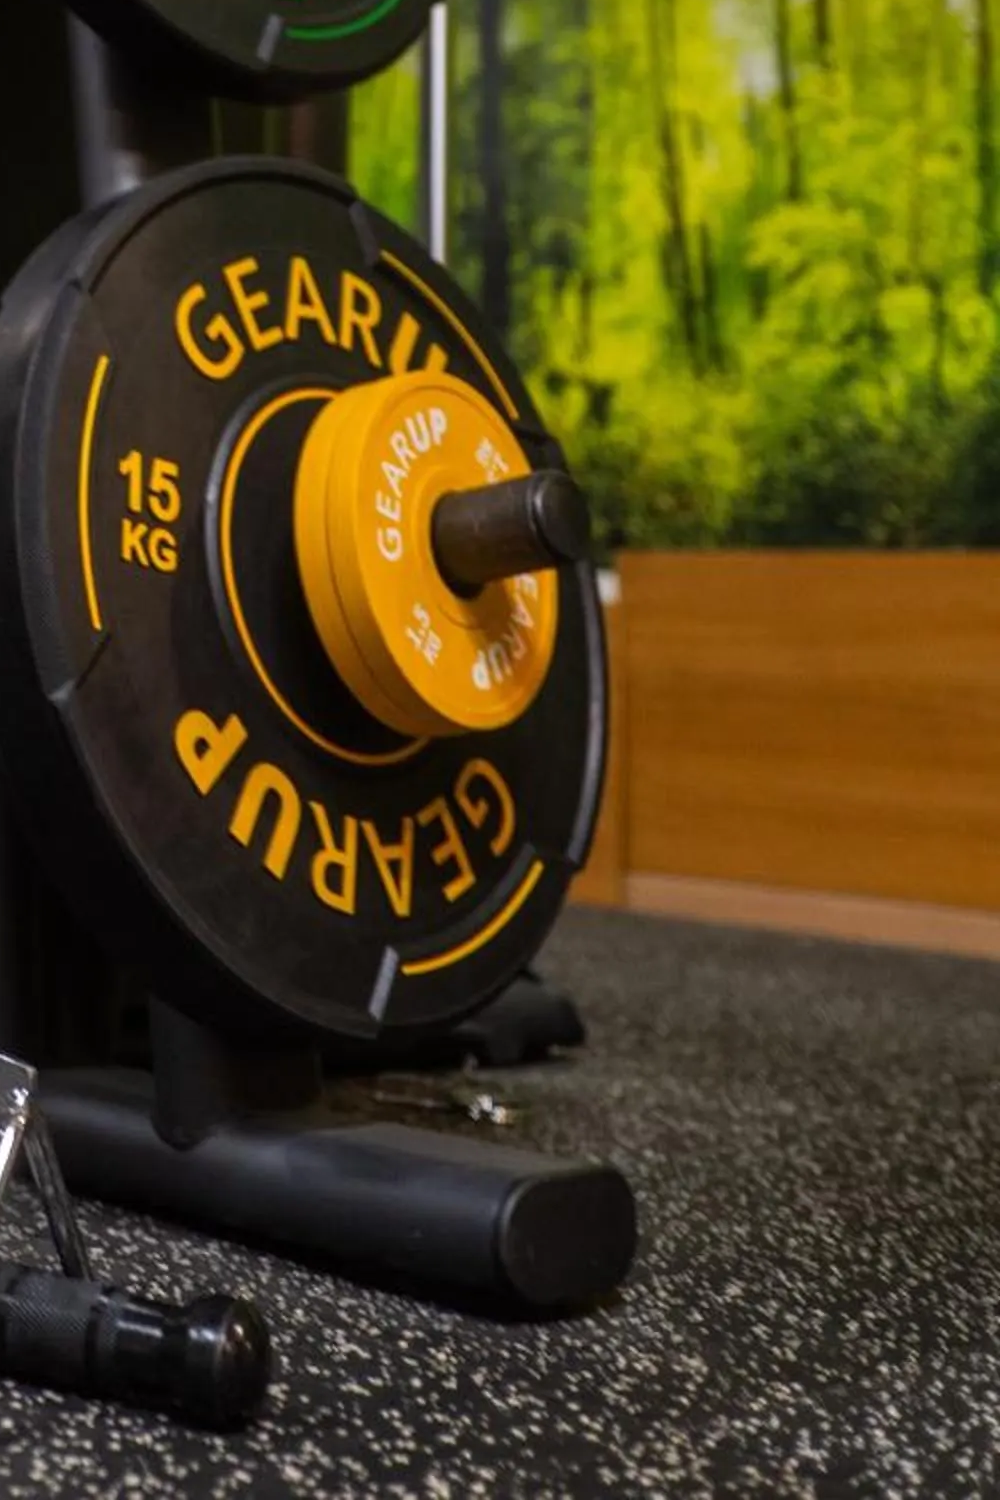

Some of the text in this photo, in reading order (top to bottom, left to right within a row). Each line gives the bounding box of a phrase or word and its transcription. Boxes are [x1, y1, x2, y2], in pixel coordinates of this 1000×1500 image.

[175, 255, 447, 380] GEARU
[119, 449, 181, 522] 15
[121, 517, 178, 571] KG
[375, 407, 447, 563] GEARUP
[472, 573, 538, 691] EARUP
[174, 709, 516, 918] GEARUP
